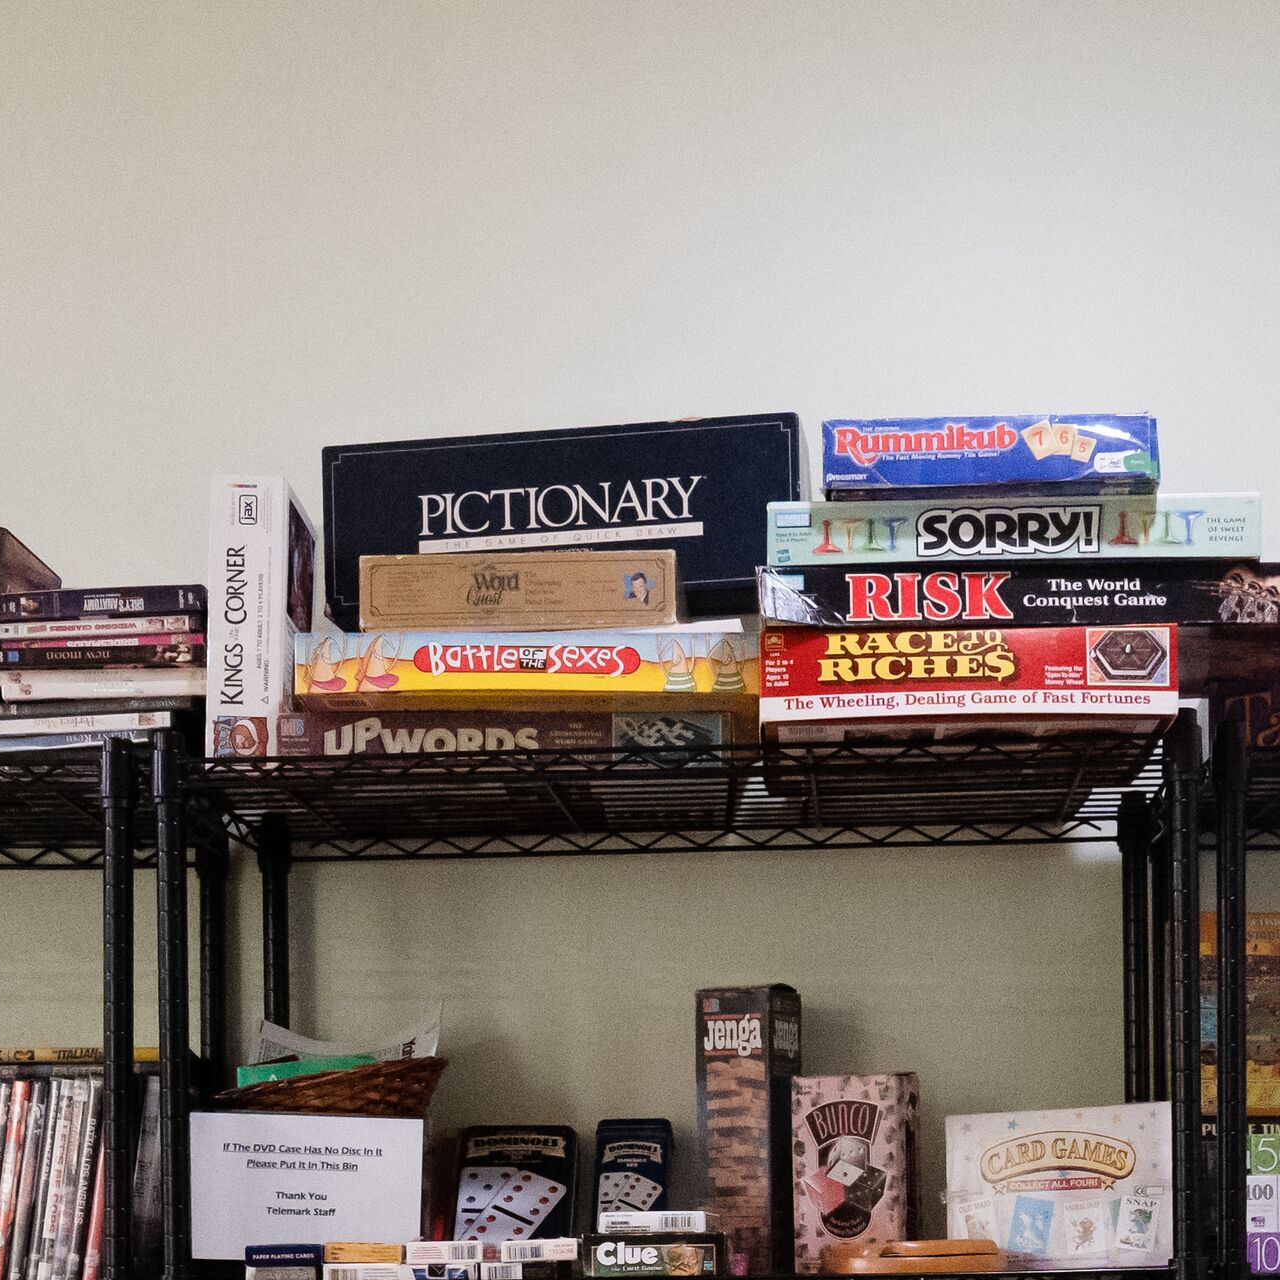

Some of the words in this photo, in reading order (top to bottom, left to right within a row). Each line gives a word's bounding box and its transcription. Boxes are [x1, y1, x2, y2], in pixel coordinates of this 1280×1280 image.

[835, 421, 1018, 466] Rummikub
[1032, 428, 1044, 446] 7
[241, 500, 254, 523] jax
[418, 476, 703, 536] PICTIONARY
[636, 527, 678, 536] DRAW
[918, 506, 1099, 553] SORRY!
[224, 545, 248, 626] CORNER
[474, 571, 520, 593] Word
[1047, 578, 1083, 591] The
[1087, 577, 1142, 592] World
[845, 571, 1015, 623] RISK
[1022, 593, 1110, 609] Conquest
[1113, 593, 1168, 607] Game
[823, 630, 960, 656] RACE
[85, 651, 111, 660] new
[427, 641, 517, 677] Battle
[220, 641, 244, 706] KINGS
[783, 697, 814, 711] The
[819, 695, 901, 711] Wheeling,
[904, 693, 967, 708] Dealing
[970, 692, 1019, 706] Game
[1042, 690, 1078, 704] Fast
[1080, 689, 1152, 706] Fortunes
[703, 1013, 763, 1057] Jenga
[812, 1103, 871, 1140] BUNCO
[253, 1144, 276, 1153] DVD
[278, 1144, 302, 1153] Case
[473, 1136, 561, 1148] DOMINOES
[987, 1138, 1047, 1176] CARD
[1051, 1137, 1128, 1171] GAMES
[275, 1191, 306, 1200] Thank
[308, 1191, 328, 1201] You
[266, 1206, 311, 1216] Telemark
[313, 1207, 336, 1217] Staff
[596, 1241, 659, 1266] Clue
